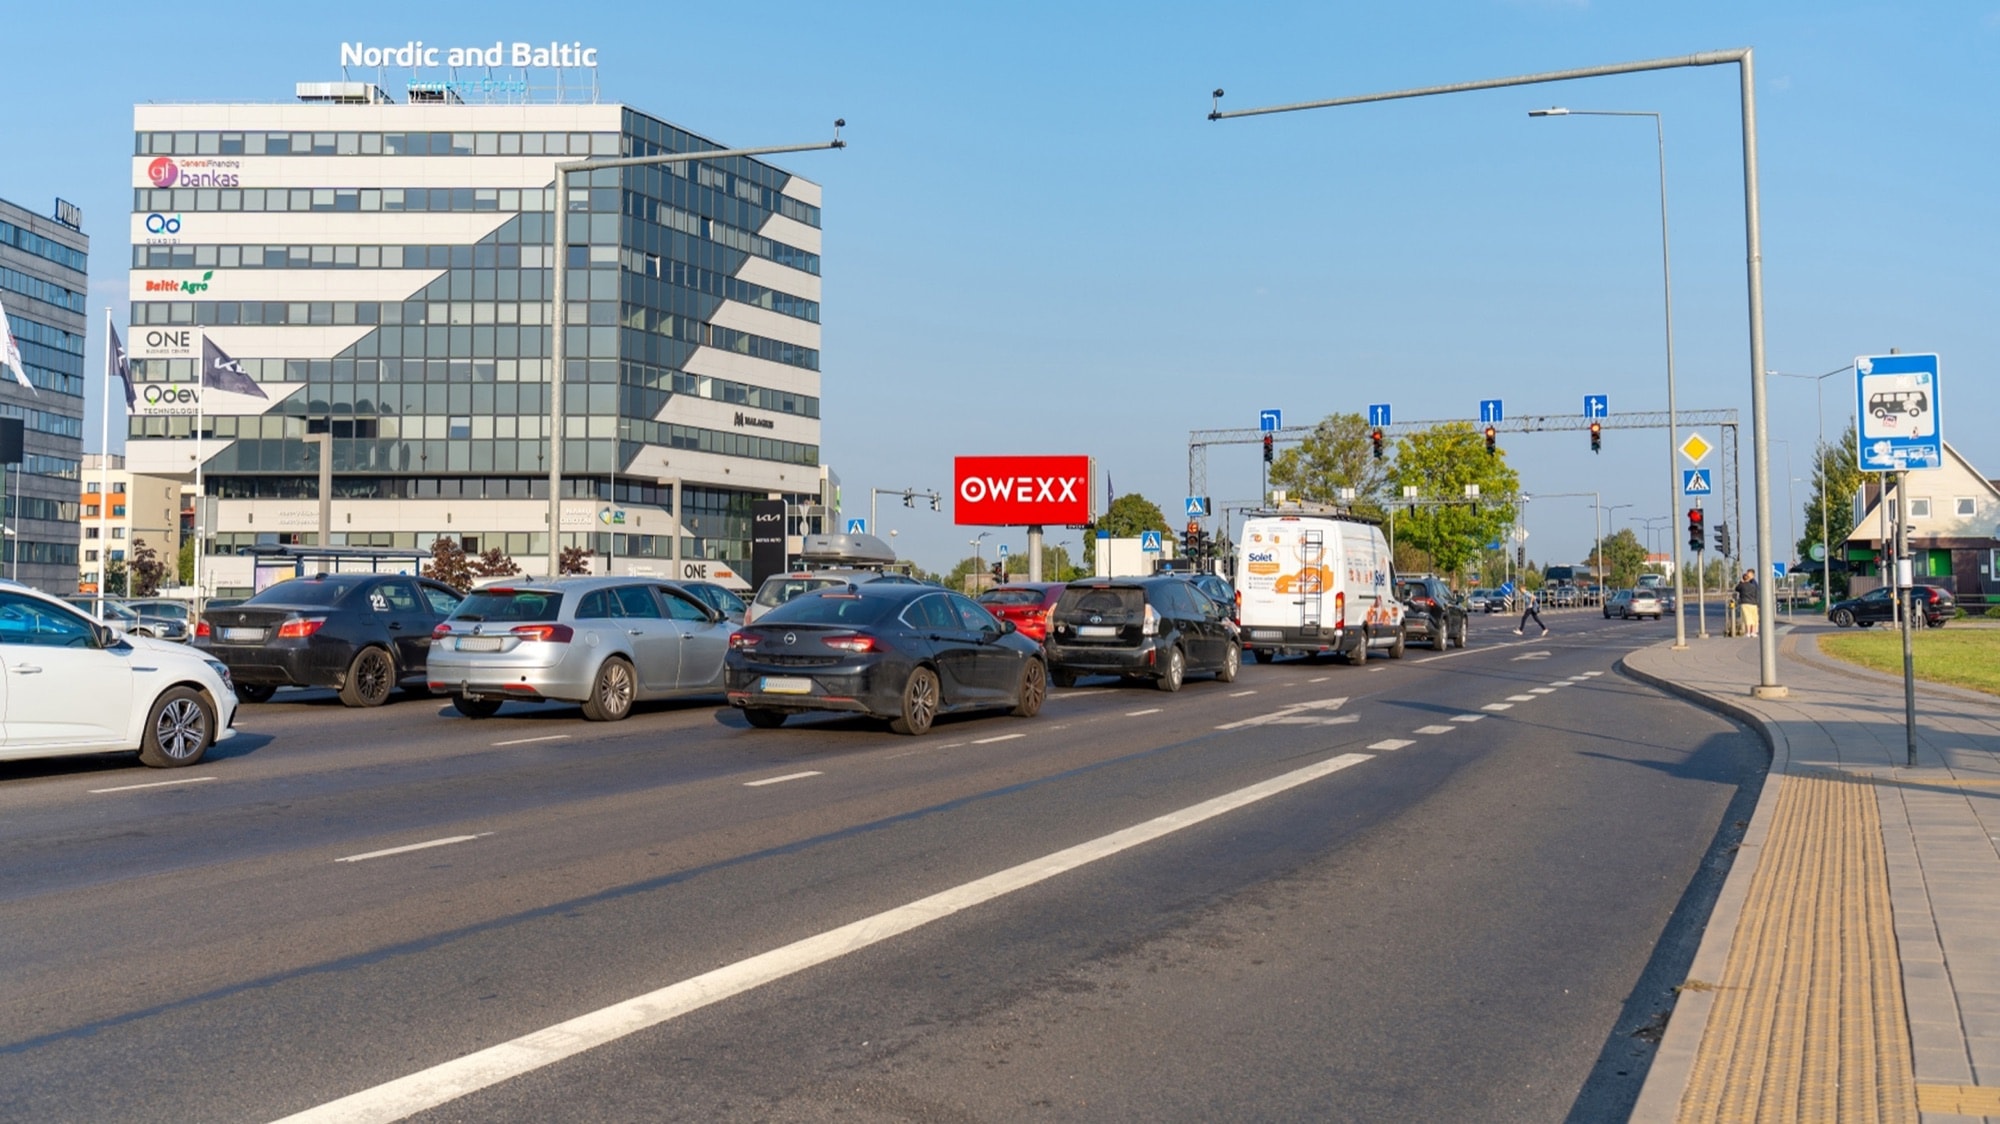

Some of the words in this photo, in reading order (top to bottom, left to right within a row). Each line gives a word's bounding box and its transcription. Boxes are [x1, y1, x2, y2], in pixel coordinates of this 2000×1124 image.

[341, 41, 438, 67] Nordic
[448, 41, 502, 67] and
[512, 41, 598, 67] Baltic
[181, 169, 239, 187] bankas
[146, 280, 179, 291] Baltic
[181, 280, 208, 294] Agro
[146, 331, 190, 347] ONE
[960, 476, 1077, 502] OWEXX
[756, 513, 781, 522] KIA
[1248, 553, 1272, 561] Solet
[684, 564, 707, 579] ONE
[370, 594, 386, 607] 22
